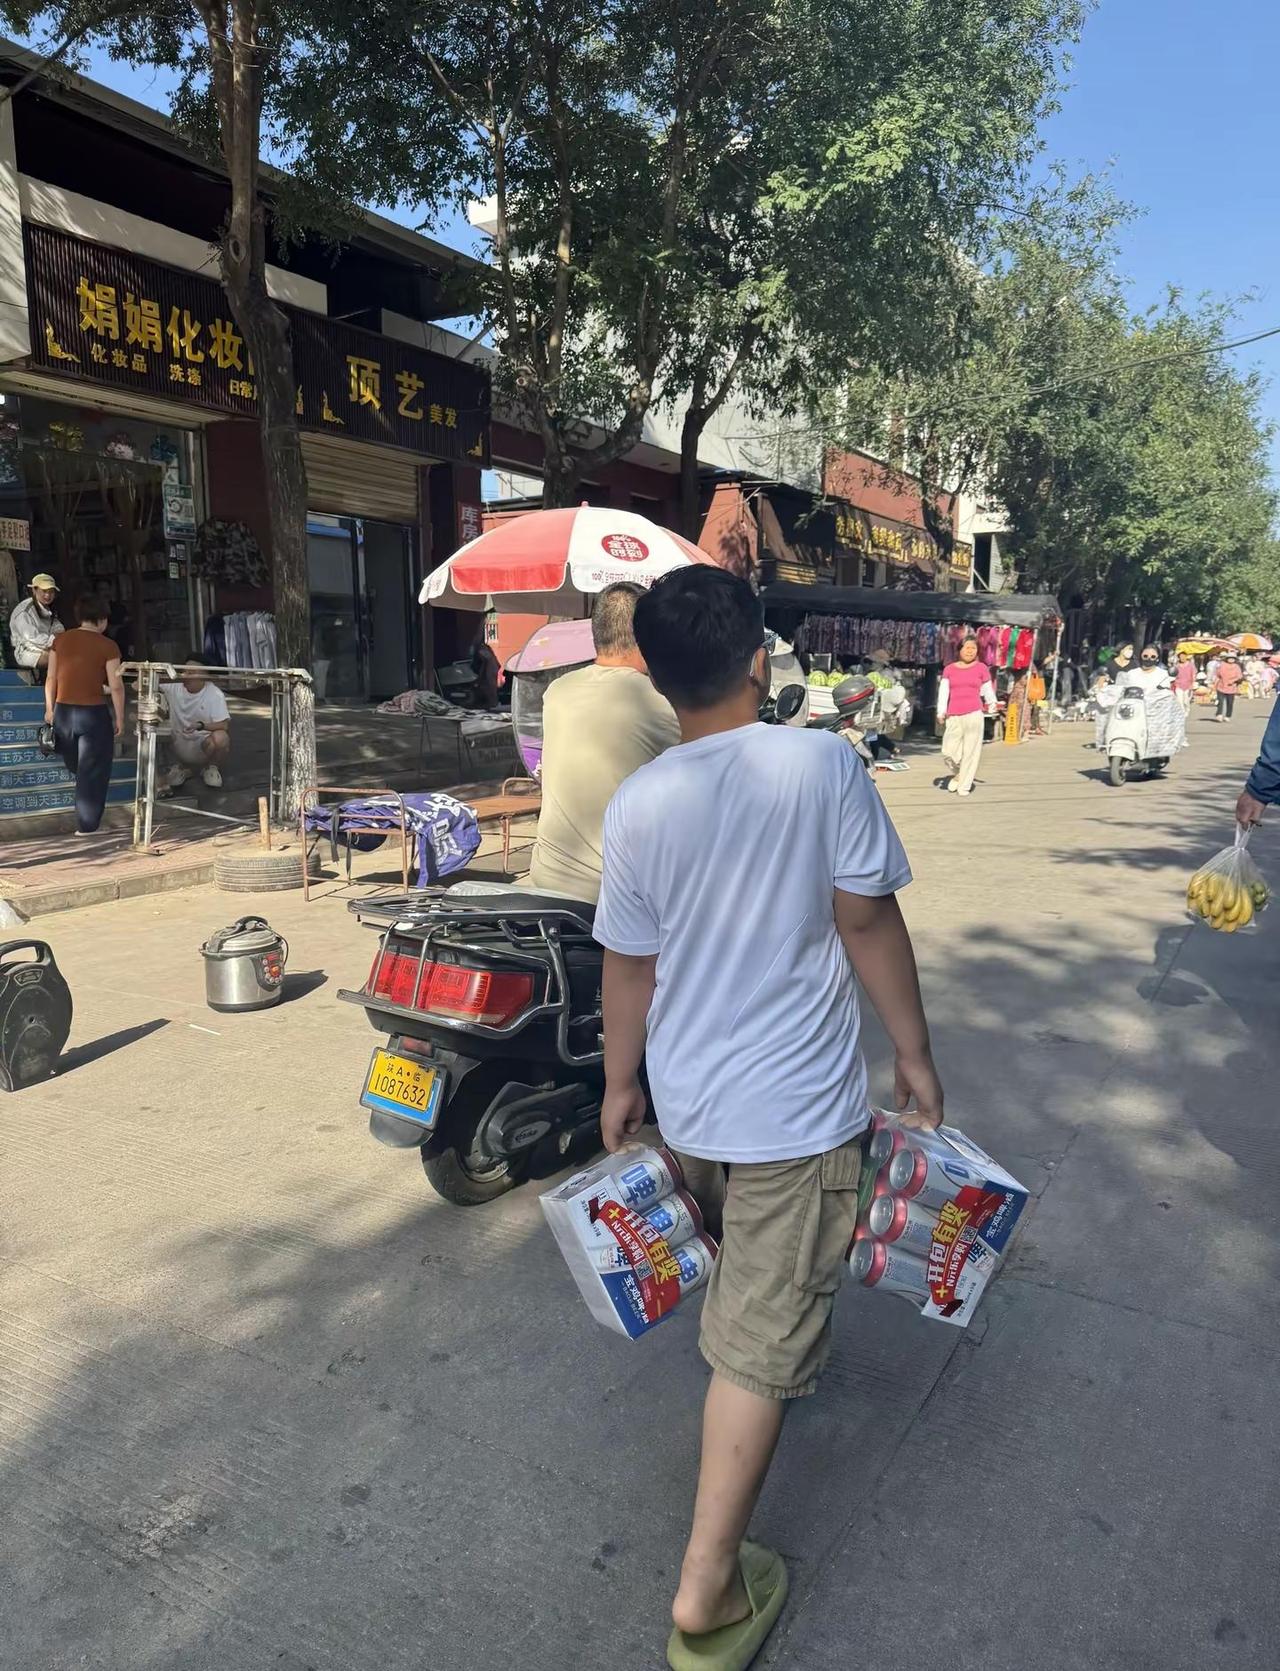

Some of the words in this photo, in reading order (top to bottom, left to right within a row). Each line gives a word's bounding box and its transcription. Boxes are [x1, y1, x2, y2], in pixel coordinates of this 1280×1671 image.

[76, 276, 255, 375] 娟娟化妆
[91, 343, 147, 373] 化妆品
[346, 355, 425, 420] 顶艺
[429, 404, 457, 429] 美发
[0, 729, 38, 740] 宁易购
[374, 1073, 426, 1106] 1087632
[621, 1164, 656, 1206] 啤
[622, 1208, 682, 1284] 开包有奖
[927, 1199, 970, 1283] 开包有奖
